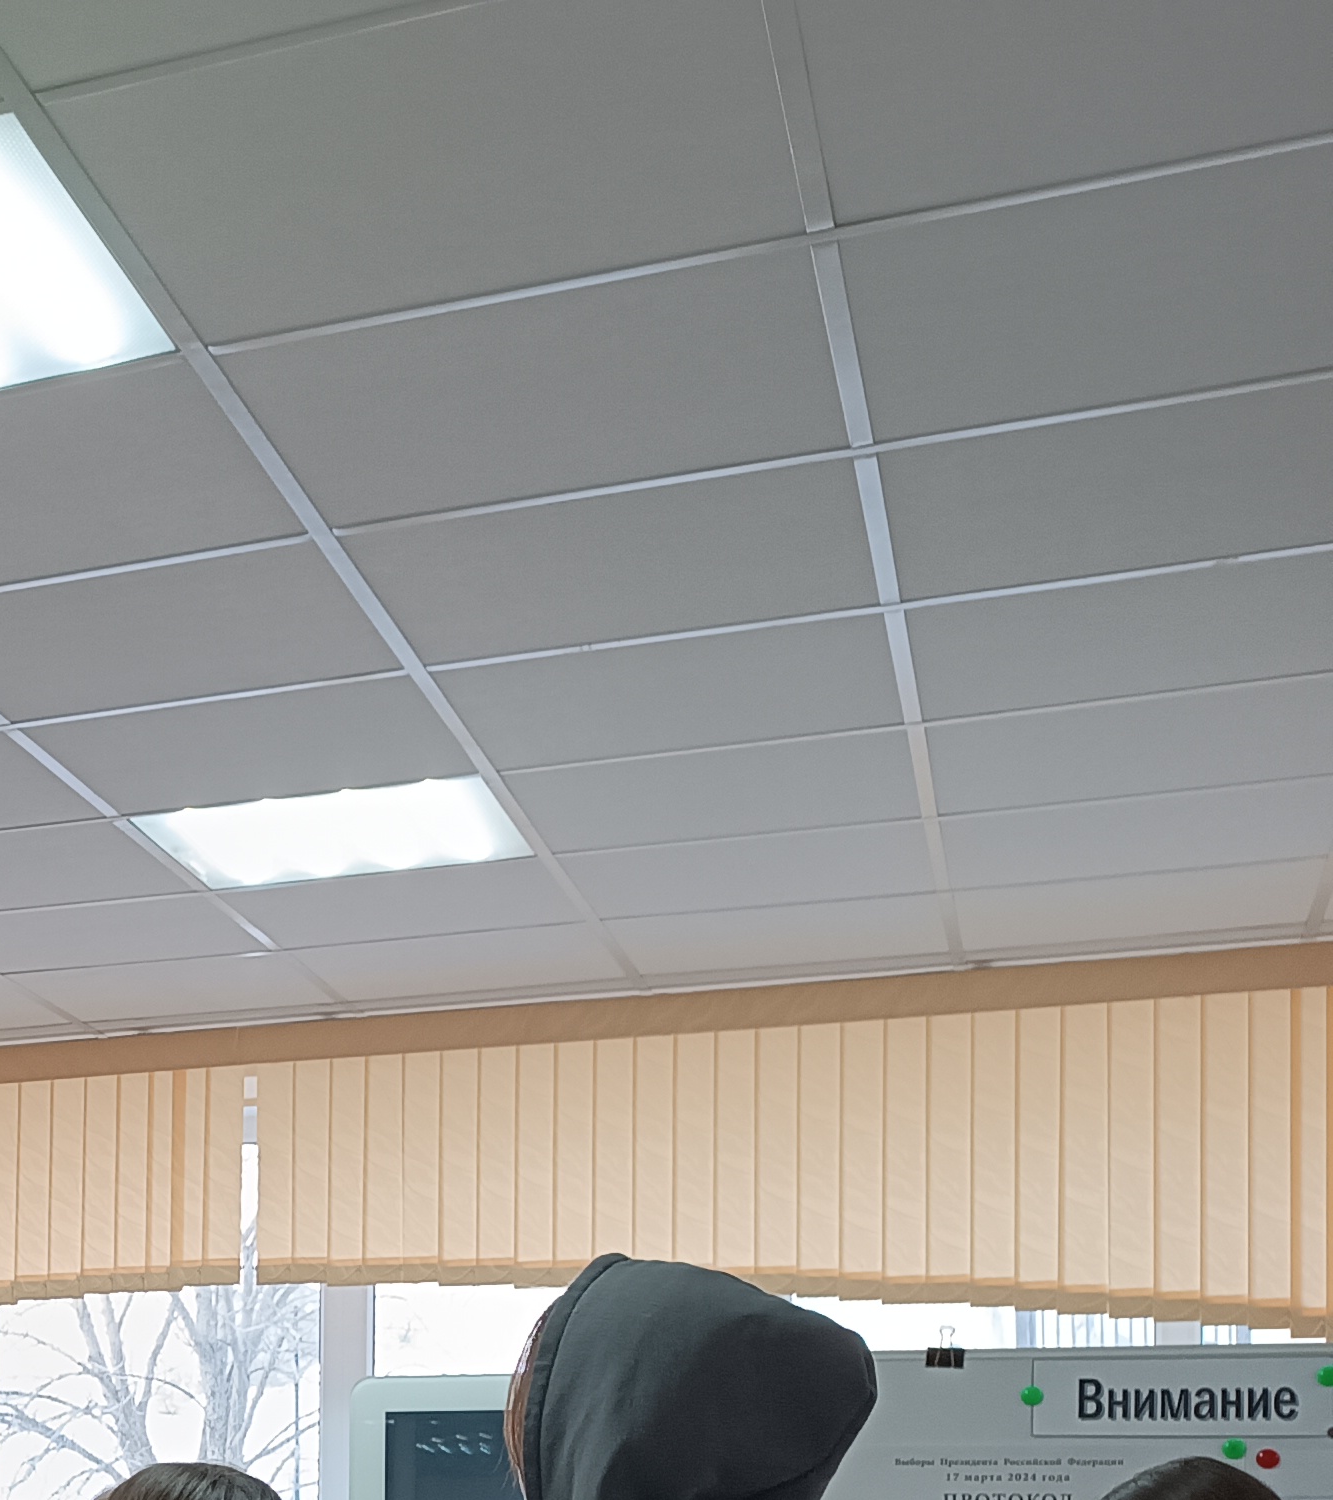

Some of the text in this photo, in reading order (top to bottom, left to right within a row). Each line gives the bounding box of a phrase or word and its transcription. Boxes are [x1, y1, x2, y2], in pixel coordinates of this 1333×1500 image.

[1078, 1378, 1299, 1421] Внимание
[894, 1457, 1124, 1468] Выборы Президента Российской Федерации
[946, 1472, 1071, 1484] 17 марта 2024 года
